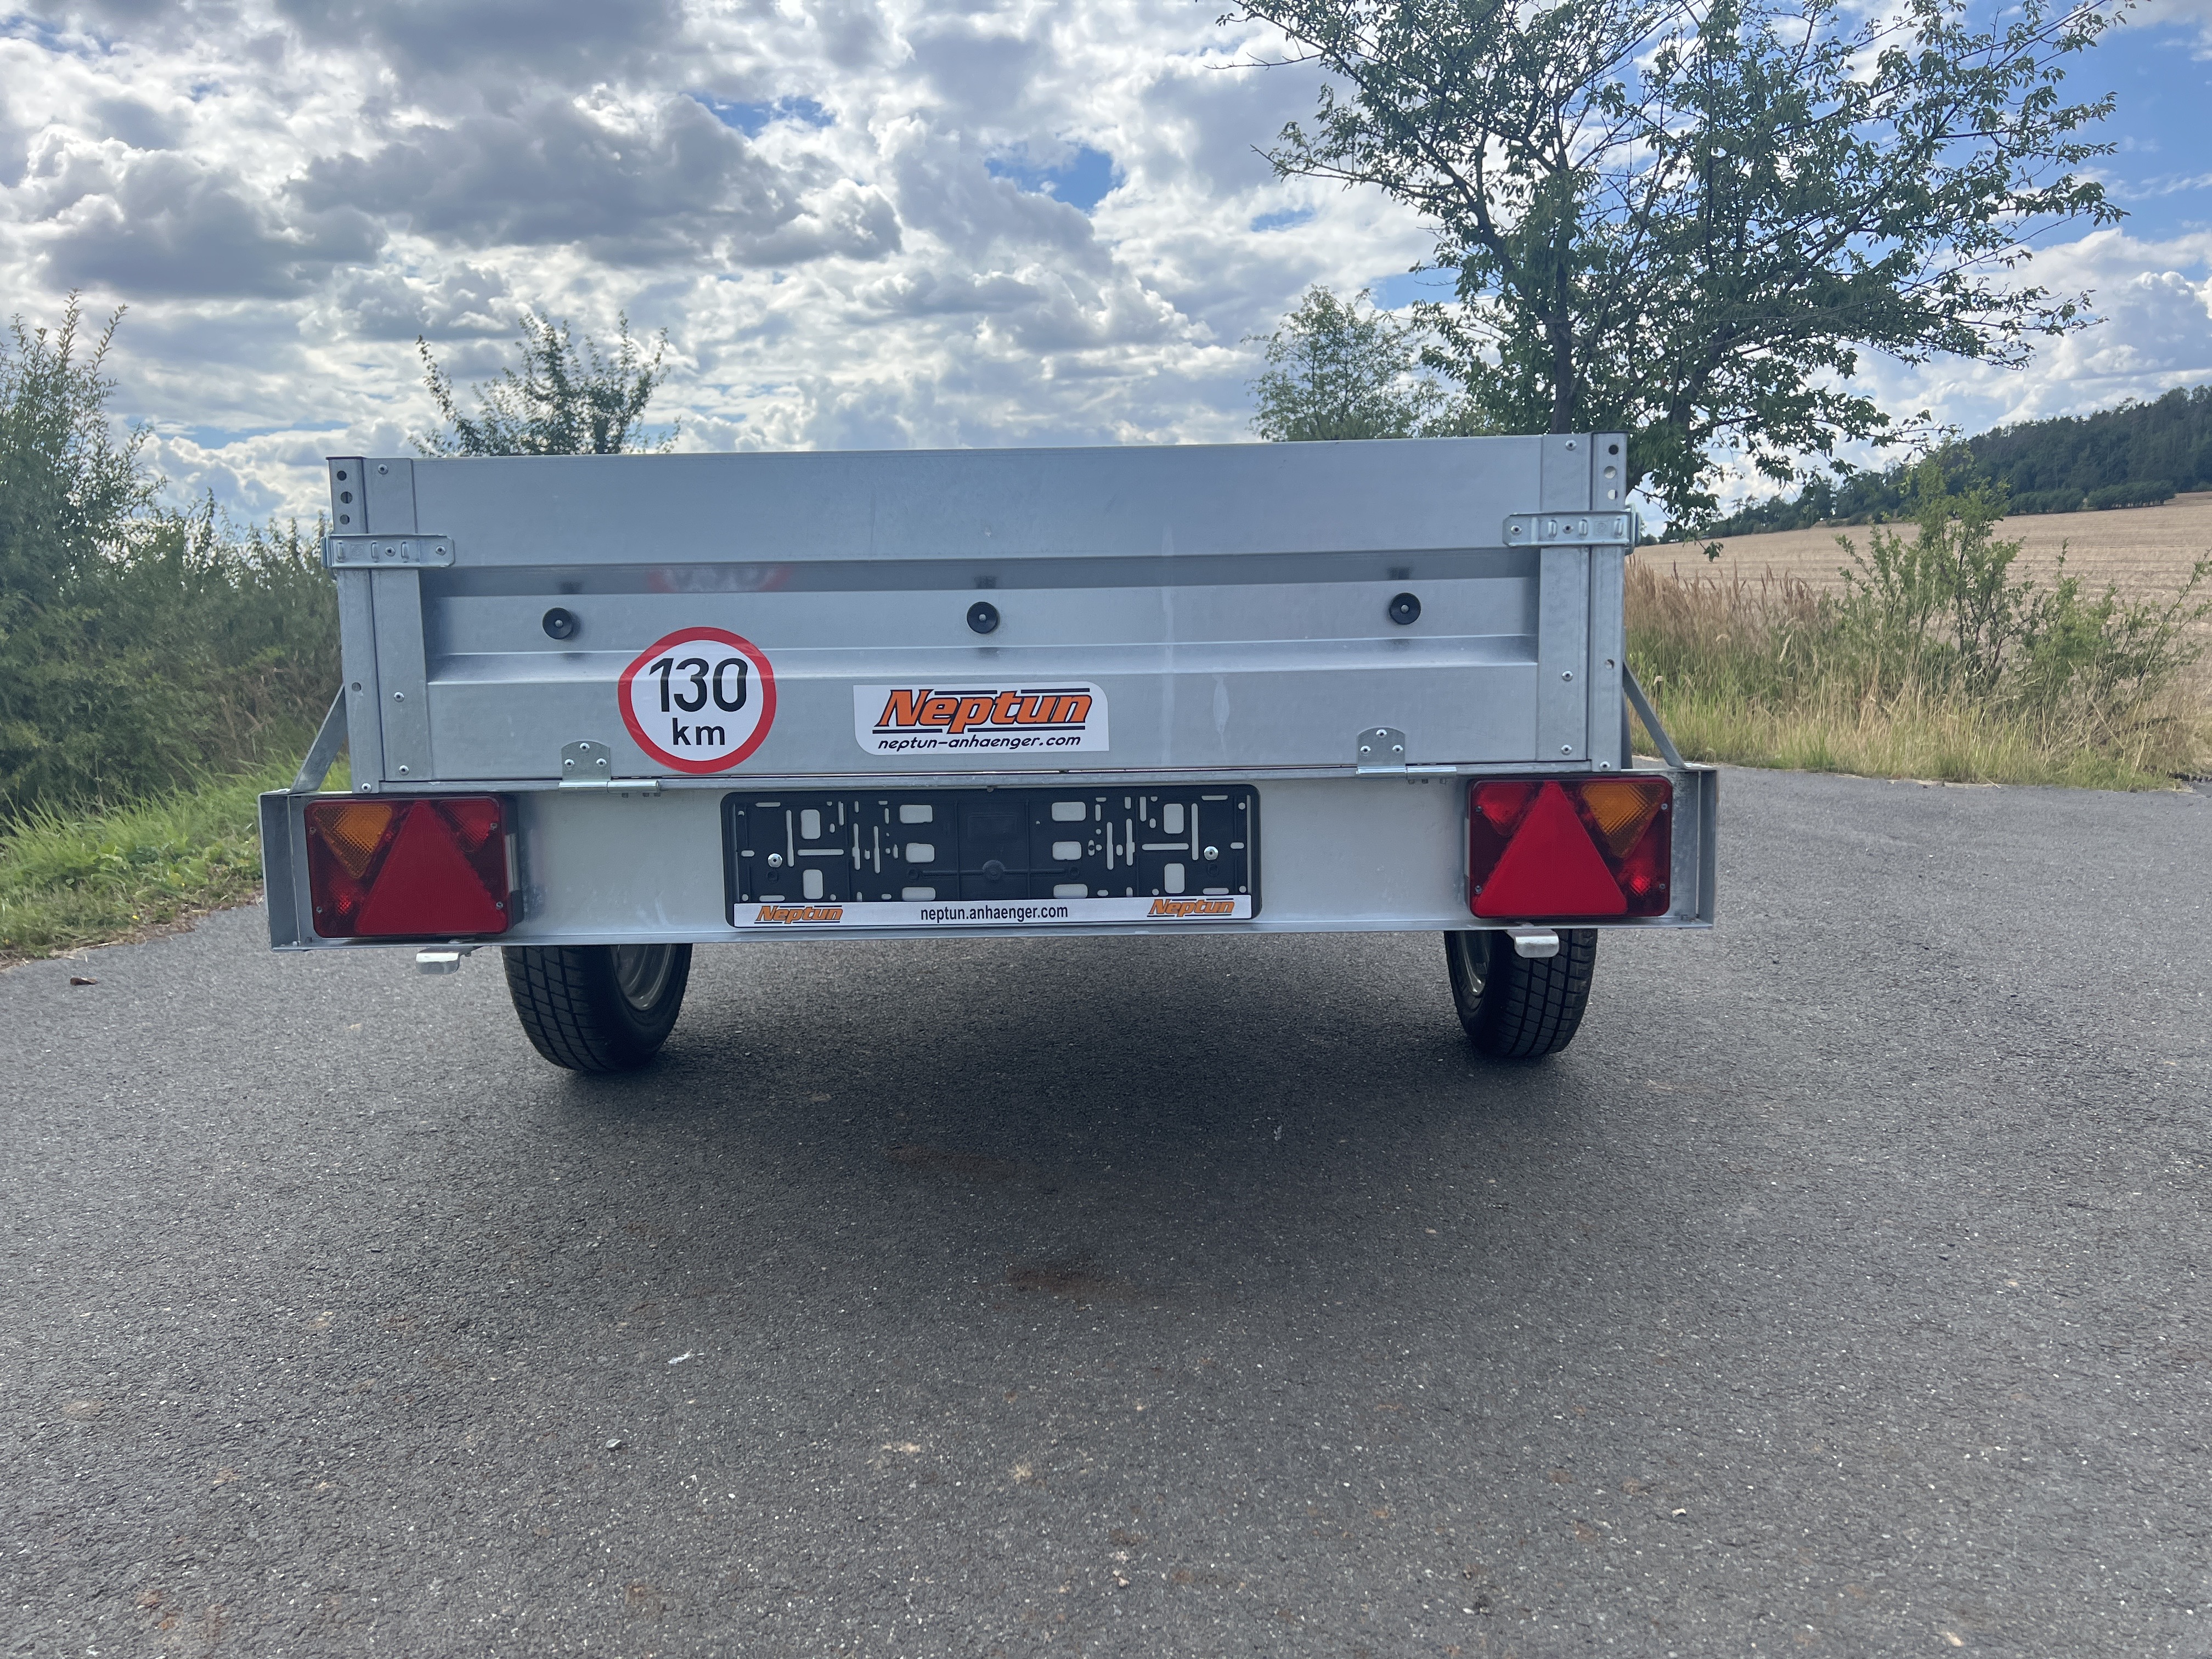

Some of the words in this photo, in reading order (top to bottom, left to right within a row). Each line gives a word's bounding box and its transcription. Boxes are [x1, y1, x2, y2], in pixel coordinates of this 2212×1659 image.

[649, 658, 748, 712] 130
[874, 689, 1092, 734] Neptun
[672, 718, 726, 746] km
[878, 735, 1081, 752] neptun-anhaenger.com
[756, 905, 843, 924] Neptun
[921, 905, 1068, 923] neptun.anhaenger.com
[1148, 899, 1235, 917] Neptun
